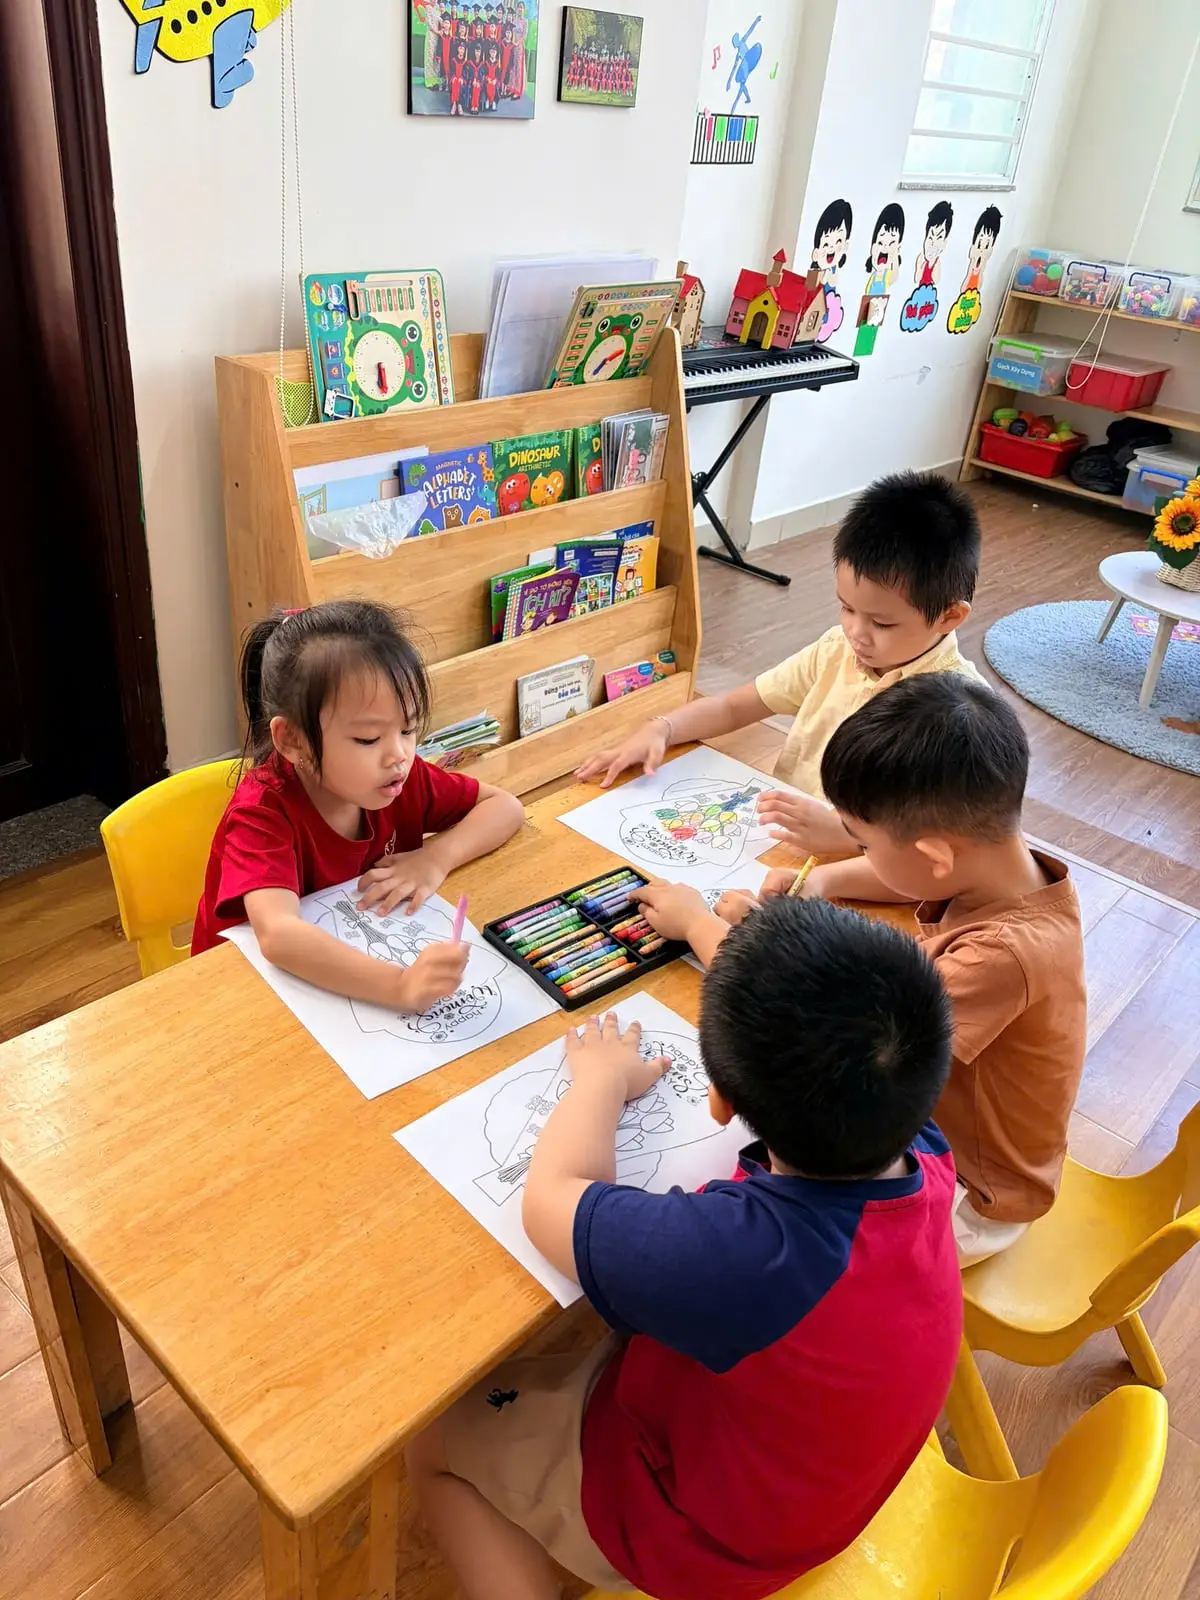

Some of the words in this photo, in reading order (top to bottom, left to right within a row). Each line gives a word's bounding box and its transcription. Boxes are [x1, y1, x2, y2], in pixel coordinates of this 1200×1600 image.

[423, 469, 476, 499] ALPHABET
[430, 484, 473, 509] LETTERS
[444, 1010, 483, 1030] happy
[667, 1043, 703, 1070] happy
